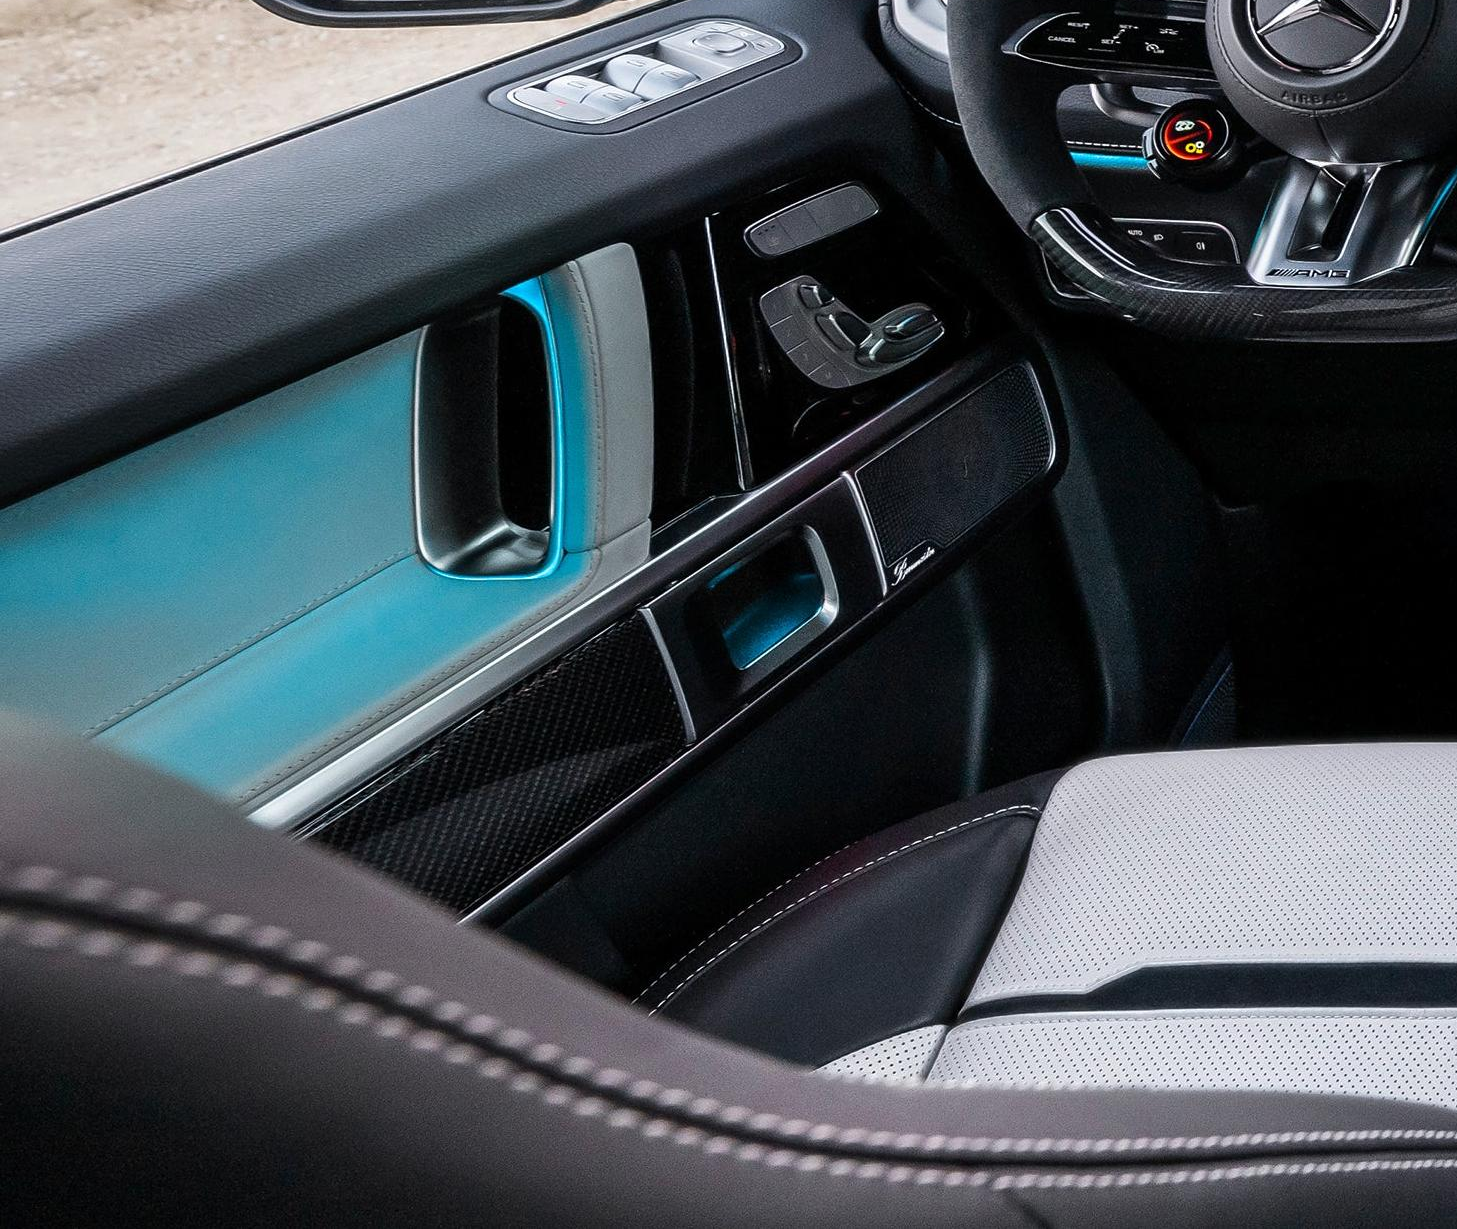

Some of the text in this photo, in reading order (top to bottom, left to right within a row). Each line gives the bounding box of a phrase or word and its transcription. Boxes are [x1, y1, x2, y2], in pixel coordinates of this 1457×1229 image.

[1047, 35, 1077, 44] CANCEL
[1280, 90, 1349, 106] AIRBAG
[1294, 269, 1351, 279] AMG
